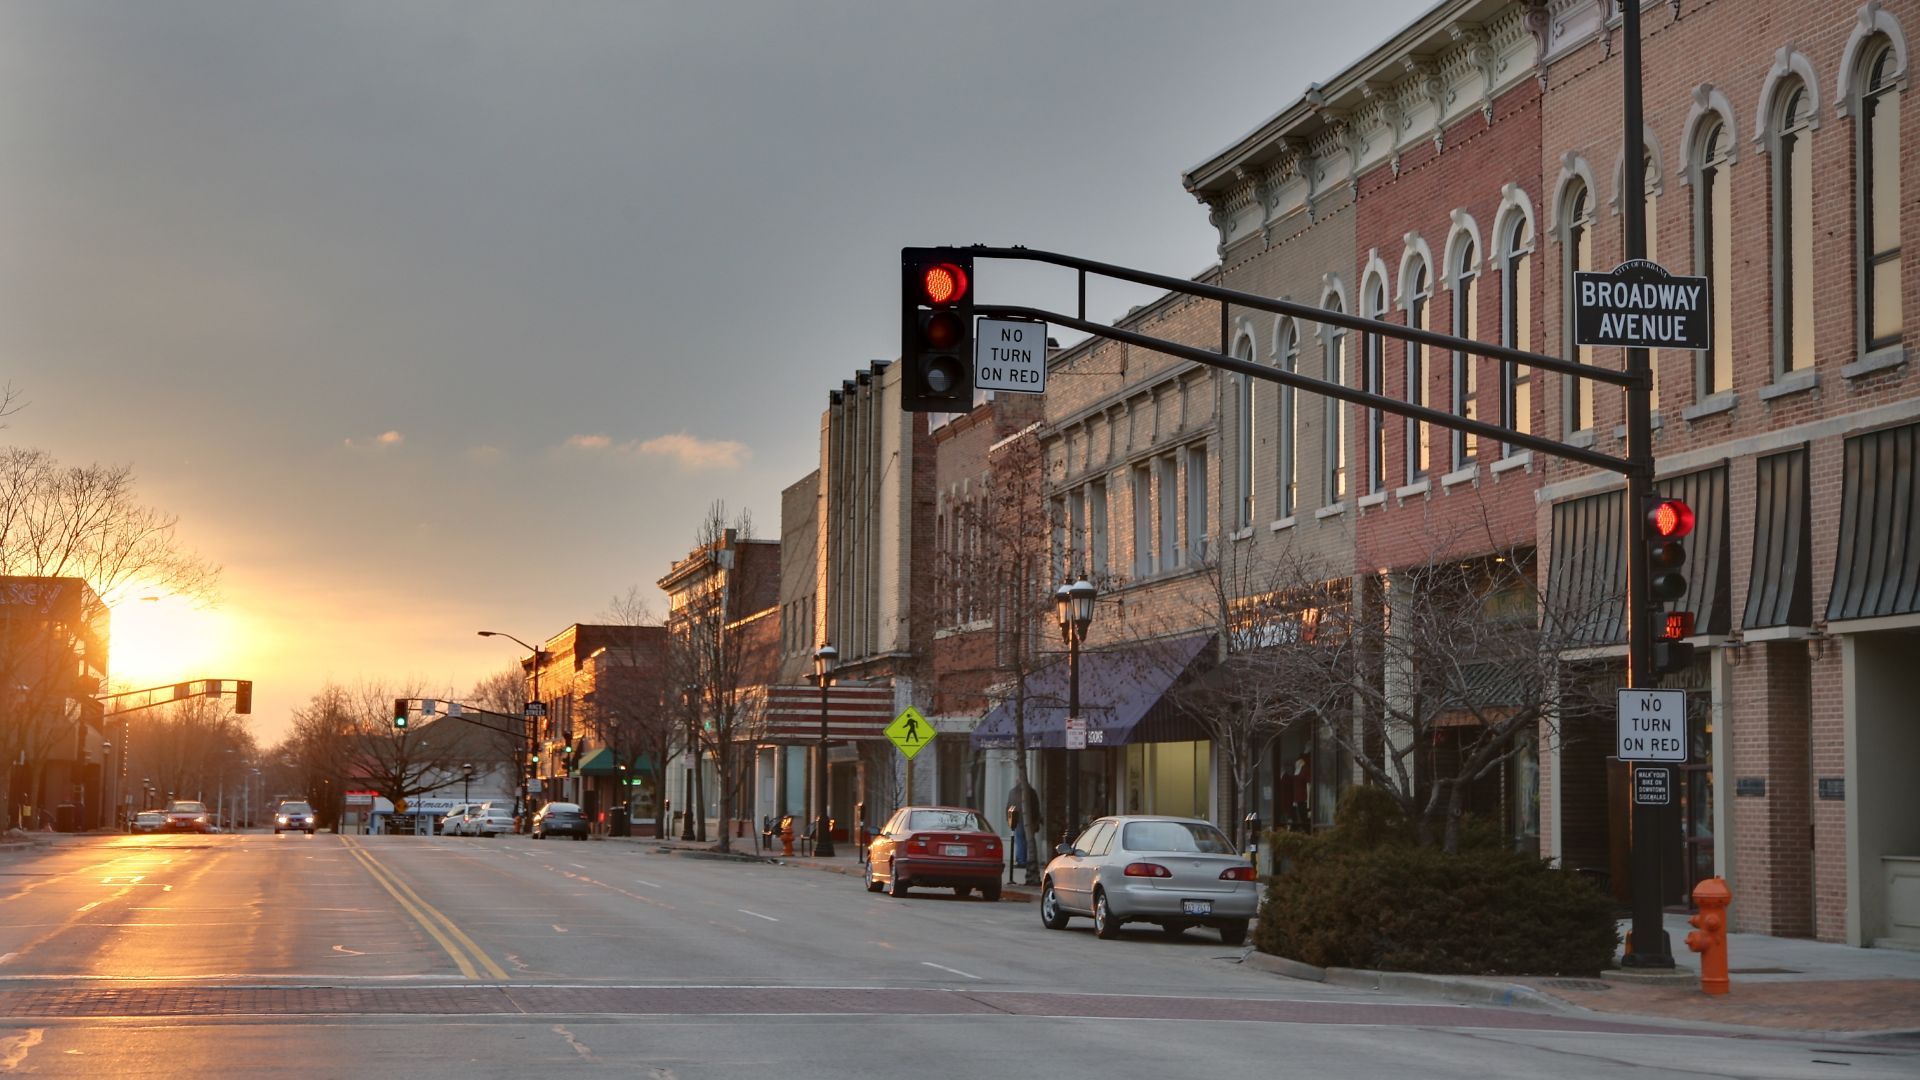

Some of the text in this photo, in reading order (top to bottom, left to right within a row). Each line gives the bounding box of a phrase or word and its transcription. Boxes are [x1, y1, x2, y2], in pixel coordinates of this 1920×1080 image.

[1614, 264, 1629, 276] CITY
[1641, 261, 1668, 278] URBANA
[1582, 281, 1700, 310] BROADWAY
[1001, 328, 1023, 342] NO
[1599, 313, 1687, 341] AVENUE
[991, 347, 1031, 363] TURN
[981, 367, 1040, 383] ON RED
[1641, 698, 1662, 712] NO
[1632, 718, 1671, 732] TURN
[1624, 738, 1680, 751] ON RED
